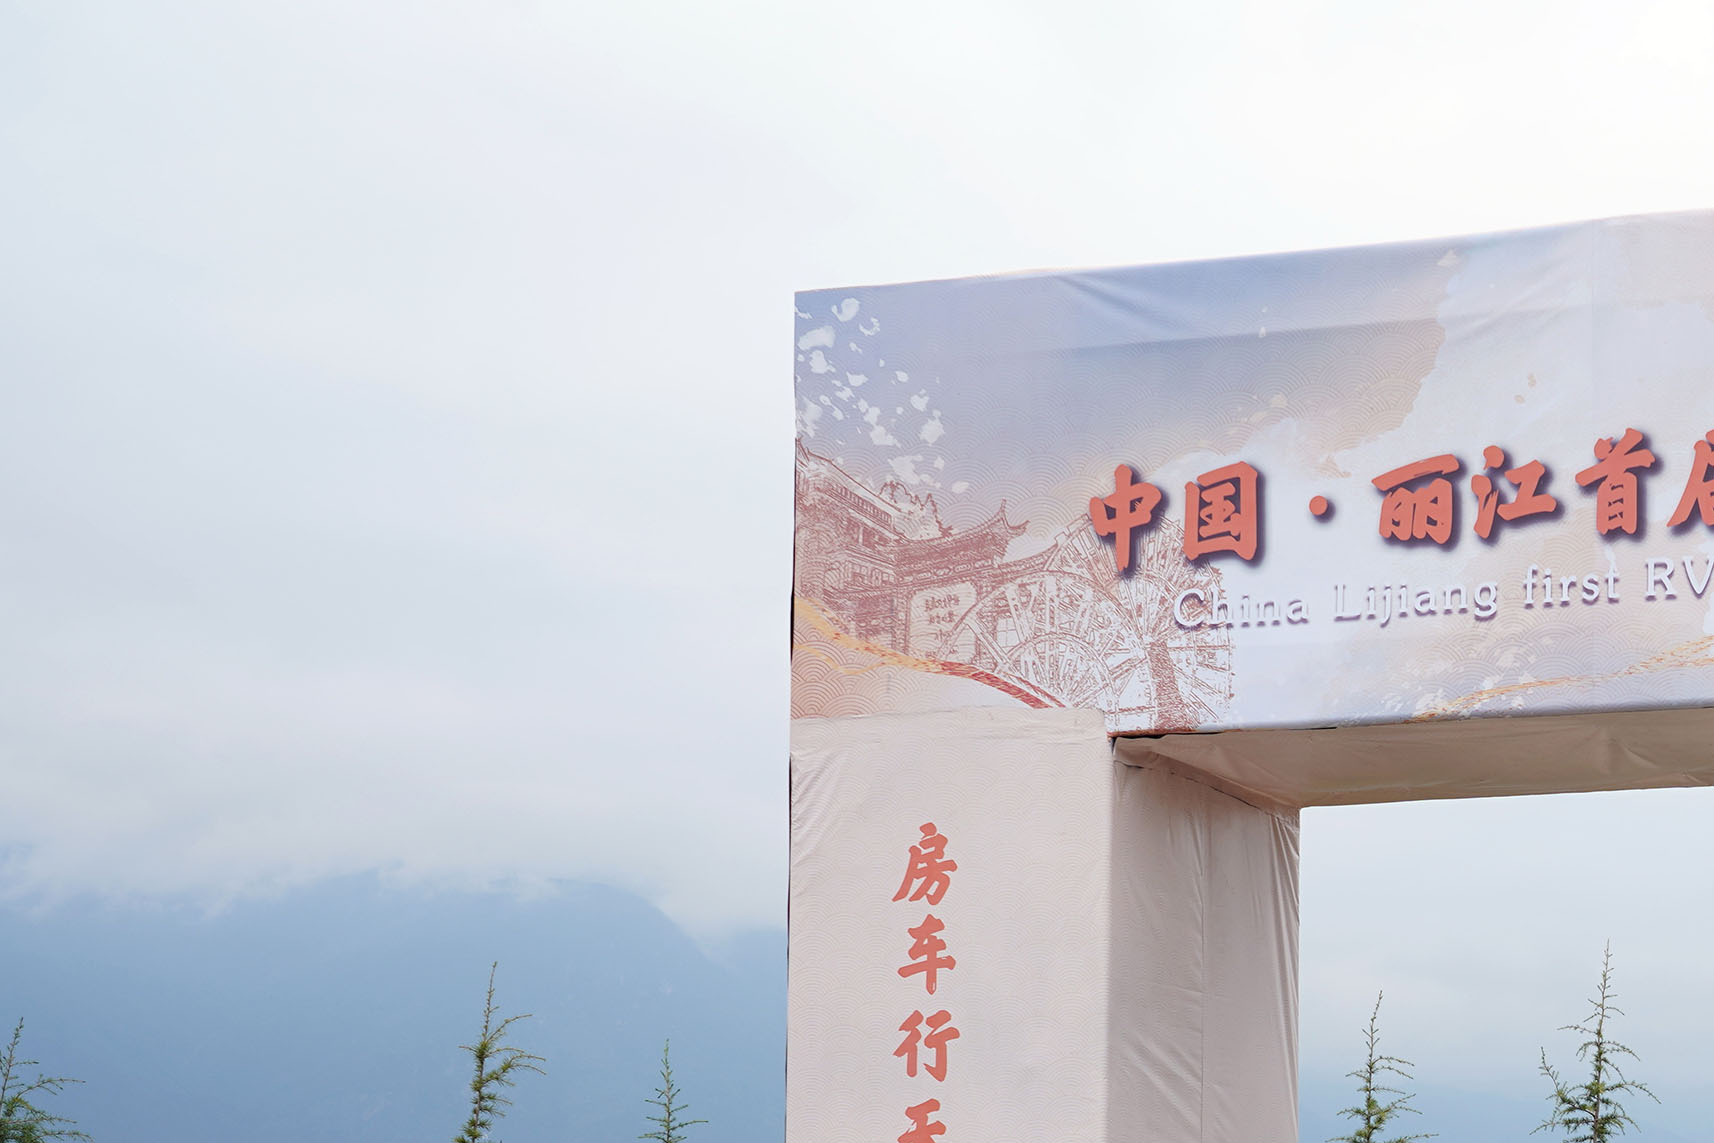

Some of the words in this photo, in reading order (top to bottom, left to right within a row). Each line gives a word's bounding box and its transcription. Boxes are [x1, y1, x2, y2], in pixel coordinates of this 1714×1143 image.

[1174, 584, 1310, 628] China
[1334, 580, 1498, 627] Lijiang
[1523, 558, 1620, 609] first
